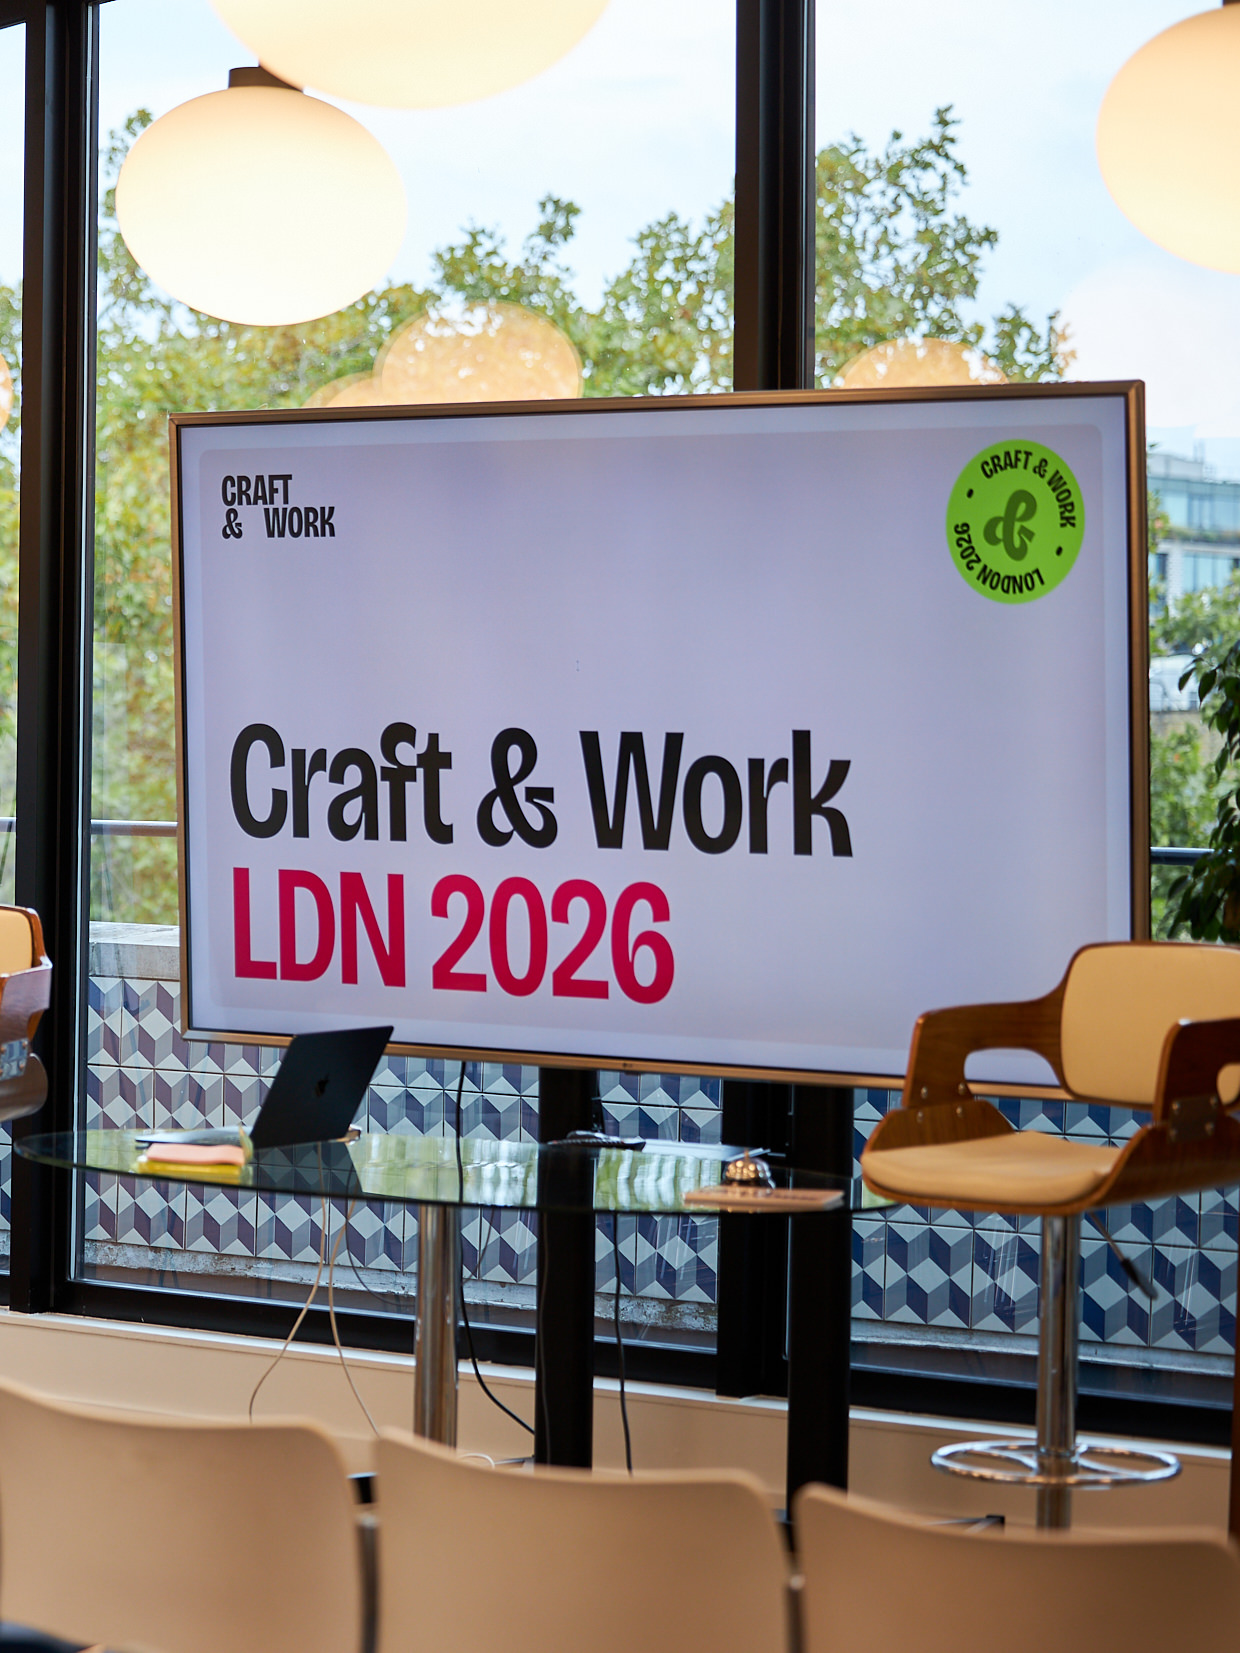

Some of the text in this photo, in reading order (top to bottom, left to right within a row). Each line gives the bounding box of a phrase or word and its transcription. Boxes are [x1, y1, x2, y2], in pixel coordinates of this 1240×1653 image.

[222, 474, 292, 506] CRAFT
[222, 506, 335, 539] & WORK
[980, 449, 1076, 528] CRAFT & WORK
[954, 522, 1045, 595] LONDON 2026
[229, 721, 854, 858] Craft & Work
[232, 866, 676, 1005] LDN 2026
